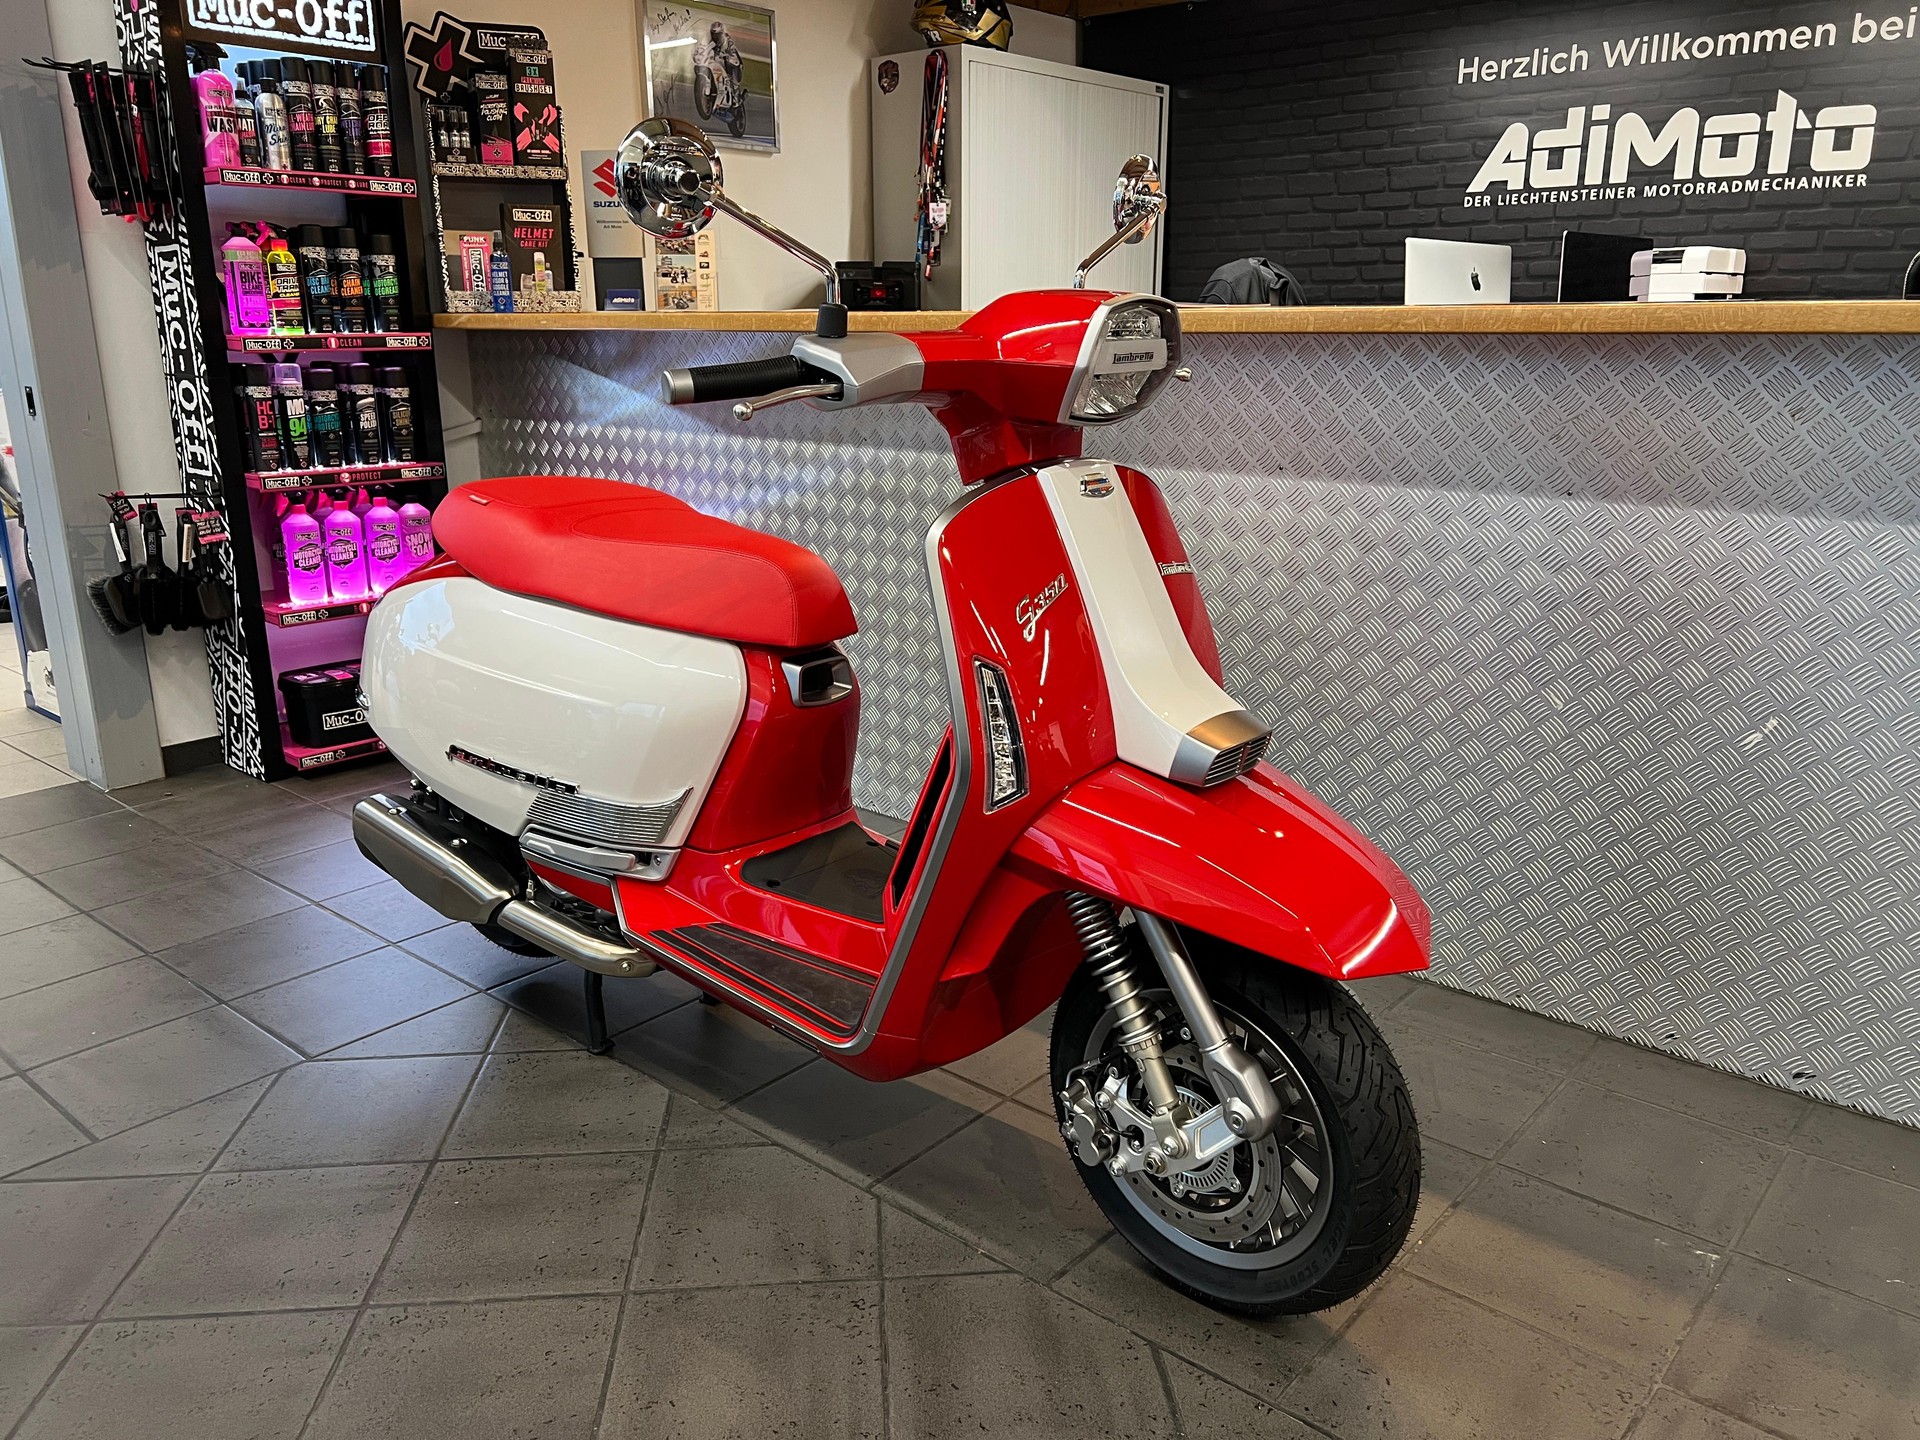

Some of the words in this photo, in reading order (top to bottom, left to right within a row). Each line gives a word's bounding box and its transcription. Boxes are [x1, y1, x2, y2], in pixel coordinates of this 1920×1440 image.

[1457, 44, 1589, 84] Herzlich
[1602, 22, 1838, 69] Willkommen
[1851, 6, 1919, 44] bei
[515, 83, 539, 93] BRUSH
[539, 85, 553, 94] SET
[368, 121, 389, 129] ROA
[1465, 89, 1878, 193] AdiMoto
[225, 171, 260, 183] Muc-Off
[289, 177, 306, 185] CLEAN
[321, 179, 342, 187] PROTECT
[372, 181, 401, 192] Muc-Off
[1463, 195, 1492, 208] DER
[1497, 186, 1637, 206] LIECHTENSTEINER
[1643, 174, 1868, 199] MOTORRADMECHANIKER
[515, 210, 550, 221] Muc-Off
[513, 227, 554, 239] HELMET
[520, 240, 536, 248] CARE
[240, 271, 262, 284] BIKE
[342, 278, 361, 287] CHAIN
[246, 340, 281, 350] Muc-Off
[339, 338, 362, 347] CLEAN
[387, 337, 417, 347] Muc-Off
[159, 256, 207, 467] Muc-Off
[266, 478, 299, 488] Muc-Off
[352, 471, 381, 480] PROTECT
[402, 467, 431, 477] Muc-Off
[405, 532, 431, 546] SNOW
[331, 551, 354, 562] CLEANER
[374, 546, 398, 557] CLEANER
[284, 612, 316, 624] Muc-Off
[326, 710, 367, 728] Muc-O
[303, 752, 334, 767] Muc-Off
